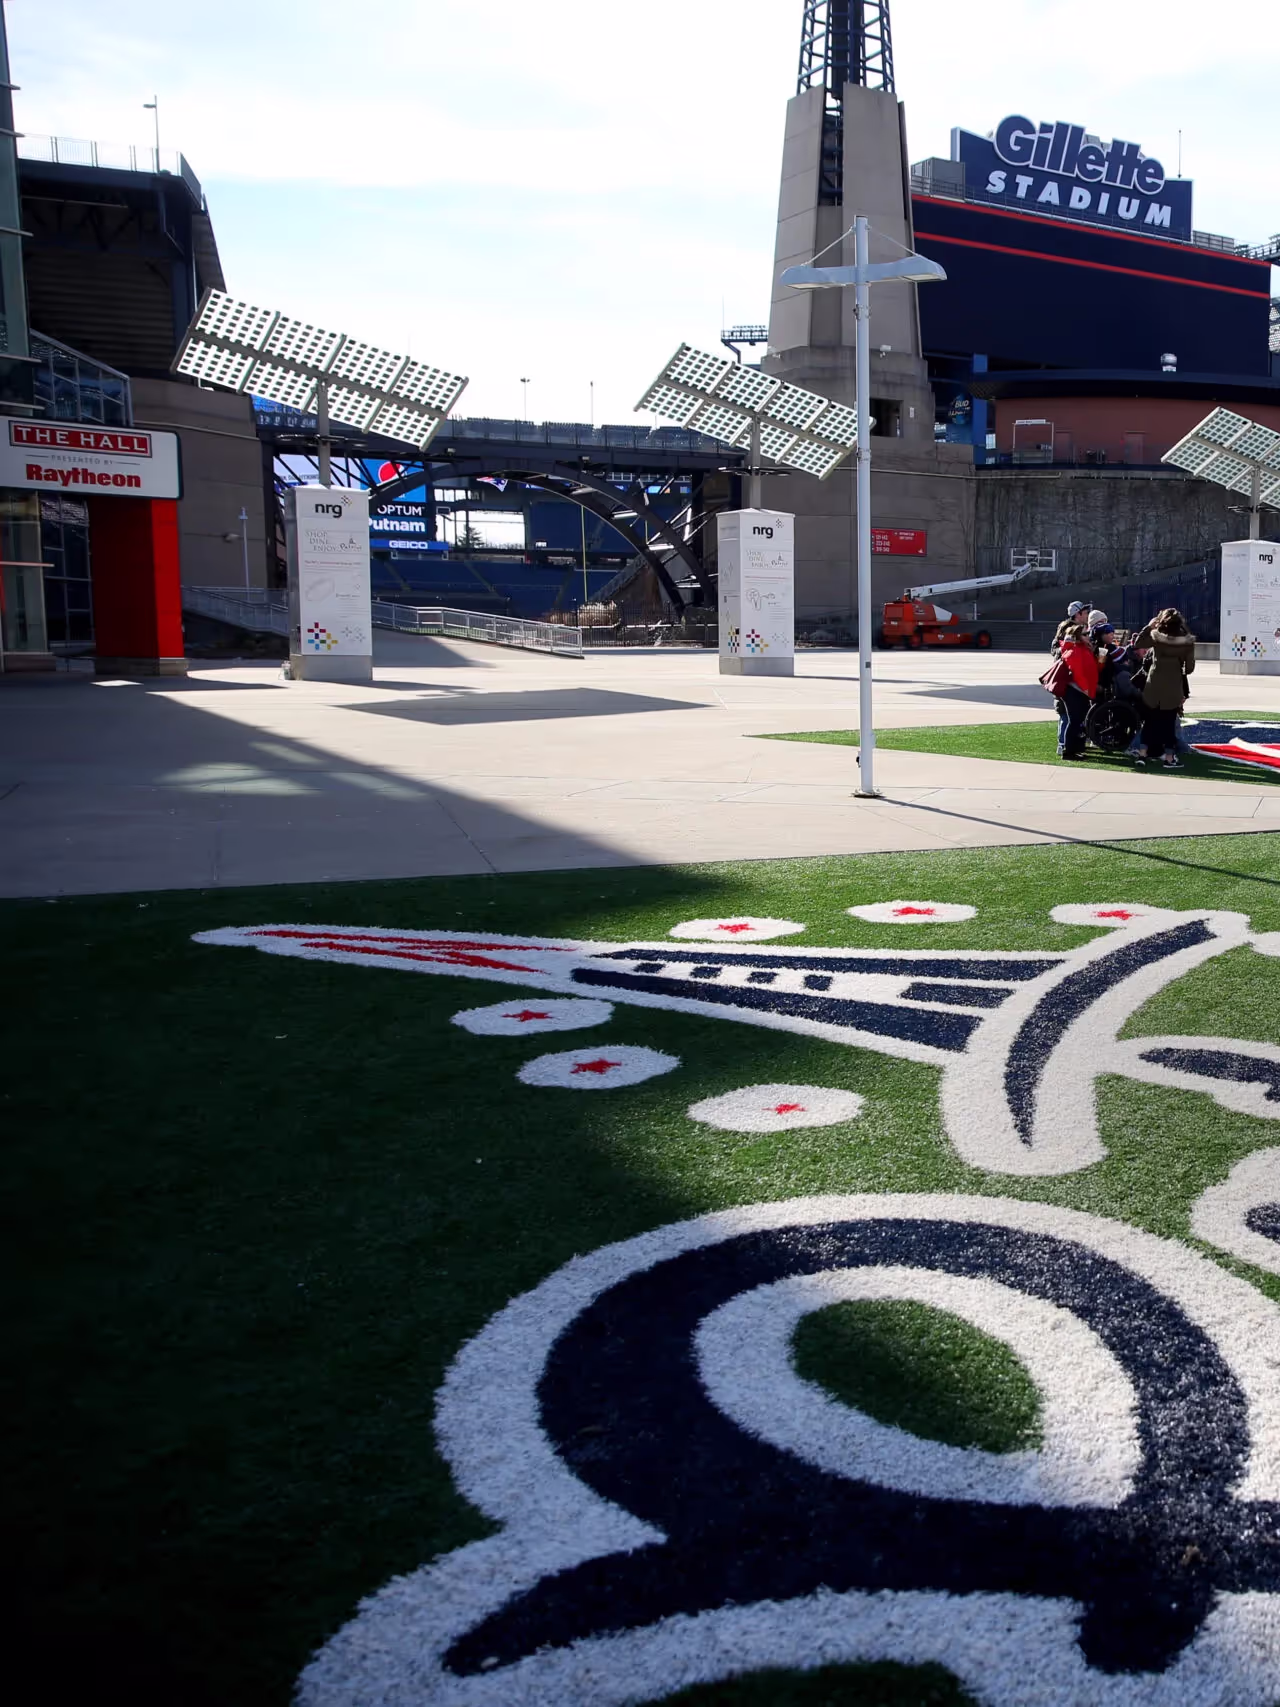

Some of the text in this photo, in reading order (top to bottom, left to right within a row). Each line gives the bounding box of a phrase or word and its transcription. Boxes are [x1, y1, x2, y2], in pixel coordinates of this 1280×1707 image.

[994, 114, 1165, 195] Gillette
[986, 170, 1172, 227] STADIUM
[17, 427, 146, 451] THE HALL
[25, 463, 142, 488] Raytheon
[315, 503, 343, 518] nrg
[377, 504, 423, 516] OPTUM
[752, 526, 774, 539] nrg
[388, 540, 429, 550] GEICO
[1258, 554, 1273, 564] nrg
